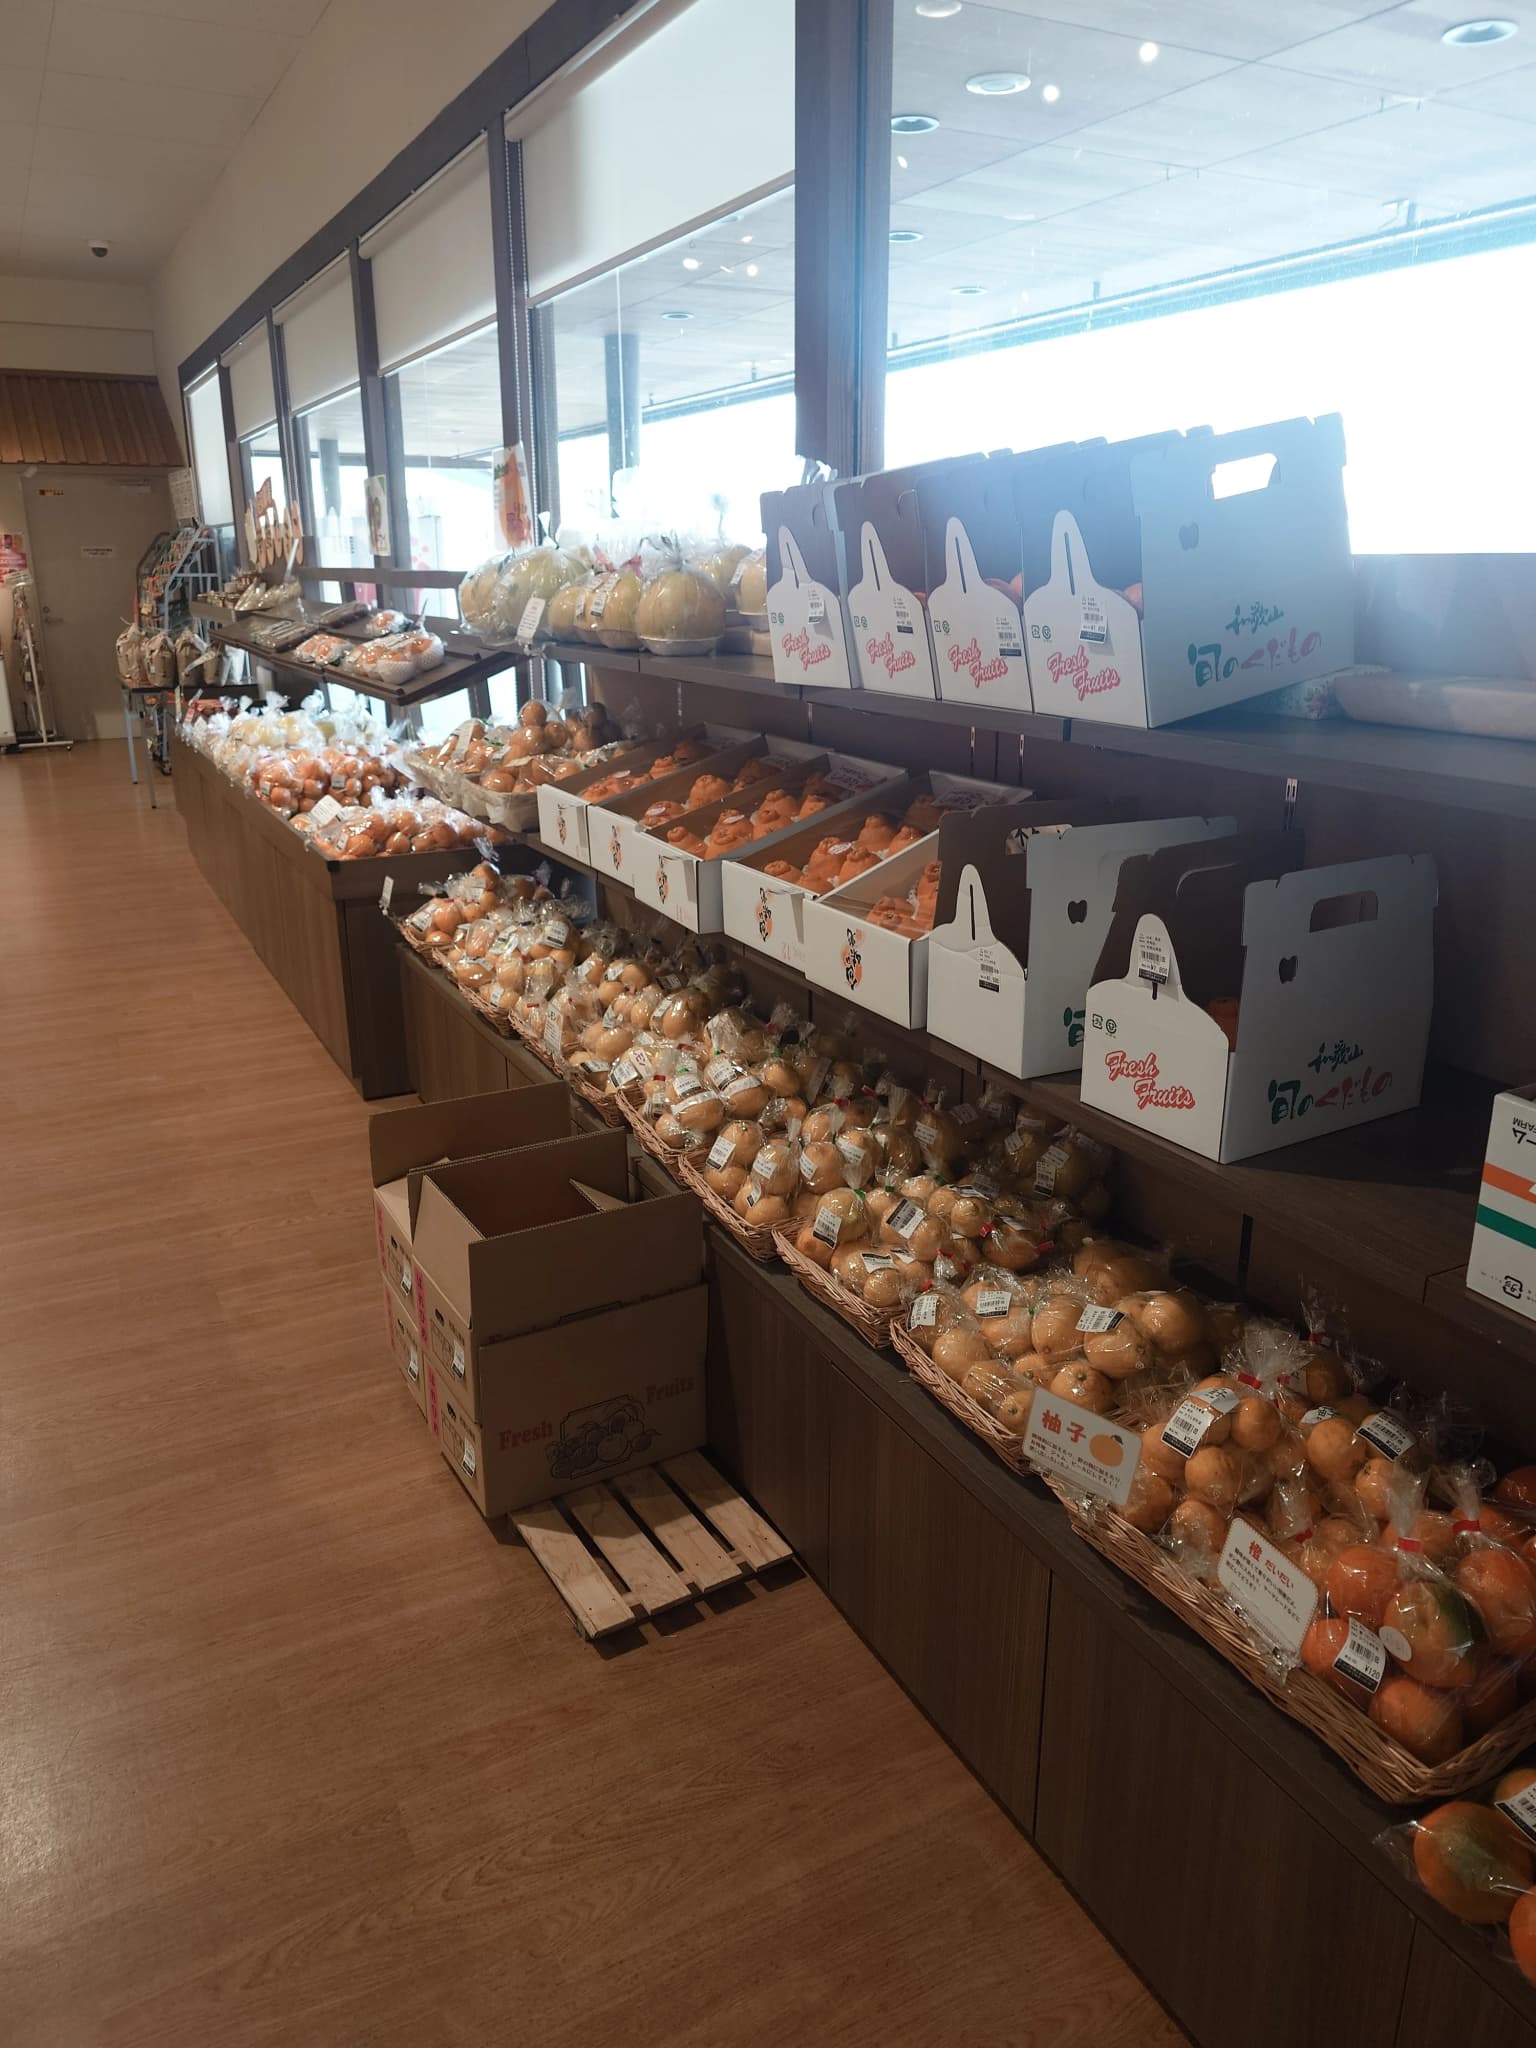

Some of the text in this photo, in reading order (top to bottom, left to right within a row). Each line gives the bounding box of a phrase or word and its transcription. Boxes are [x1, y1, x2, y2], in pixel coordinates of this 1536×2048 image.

[1225, 600, 1285, 636] 和歌山
[782, 626, 810, 660] Fresh
[800, 643, 832, 671] Fruits
[866, 632, 893, 663] Fresh
[947, 638, 980, 673] Fresh
[1187, 626, 1322, 688] 旬のくだもの
[883, 649, 916, 679] Fruits
[968, 656, 1008, 689] Fruits
[1046, 645, 1090, 684] Fresh
[1071, 666, 1121, 701] Fruits
[1105, 1049, 1160, 1082] Fresh
[1307, 1039, 1364, 1074] 和歌山
[1133, 1078, 1196, 1111] Fruits
[1267, 1065, 1393, 1125] 旬のくだもの
[644, 1376, 695, 1407] Fruits
[499, 1418, 554, 1451] Fresh
[1041, 1408, 1087, 1444] 柚子
[1264, 1559, 1294, 1589] だいだい
[1364, 1664, 1381, 1680] ¥120
